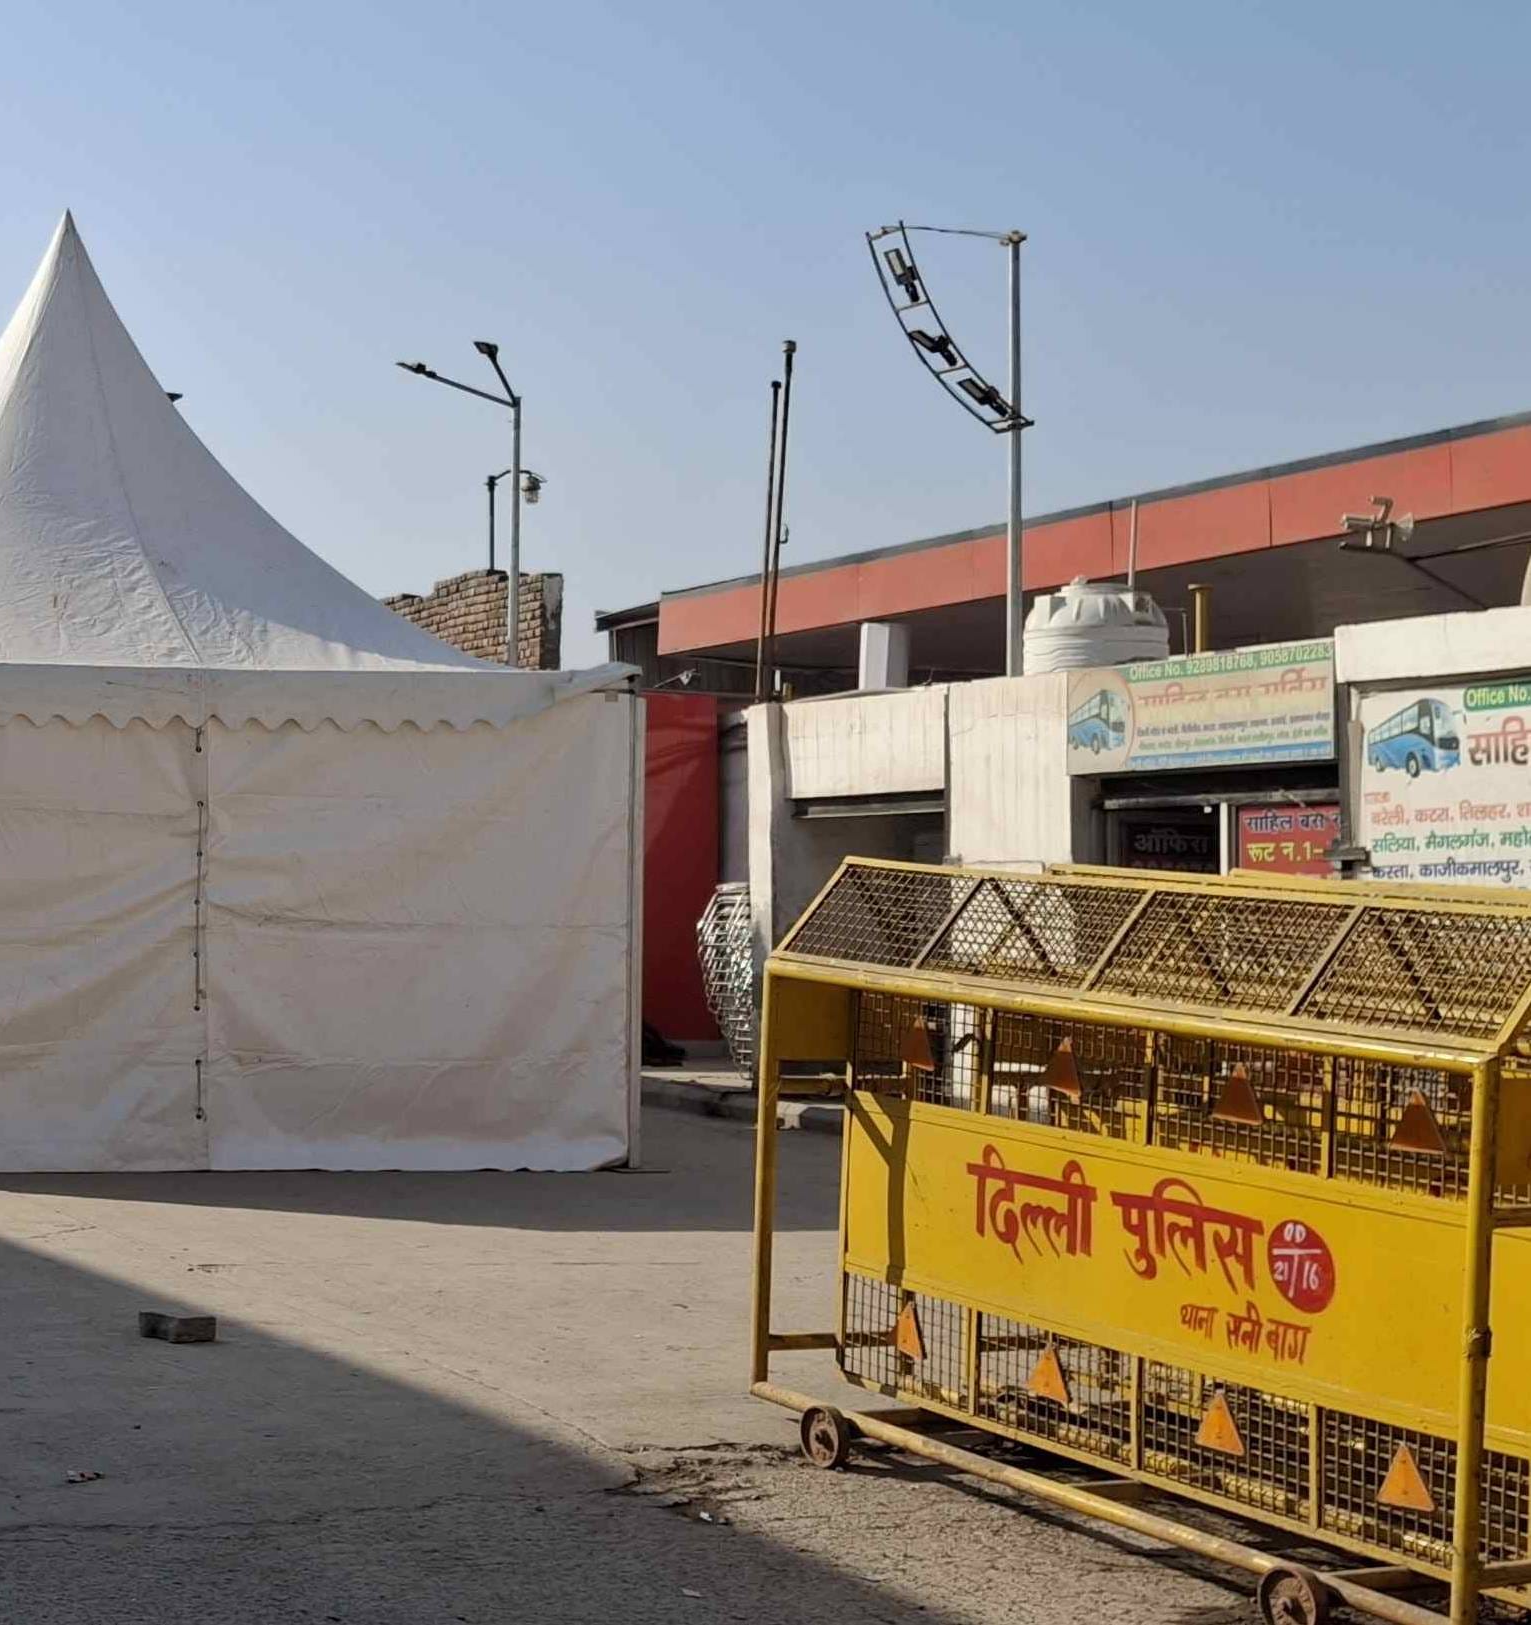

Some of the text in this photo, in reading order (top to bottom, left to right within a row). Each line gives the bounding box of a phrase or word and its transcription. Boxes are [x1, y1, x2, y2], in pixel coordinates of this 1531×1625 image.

[1129, 663, 1162, 681] Office
[1466, 686, 1505, 707] Office
[966, 1143, 1265, 1295] दिल्ली पुलिस
[1180, 1303, 1219, 1340] थाना
[1266, 1317, 1312, 1366] बाग
